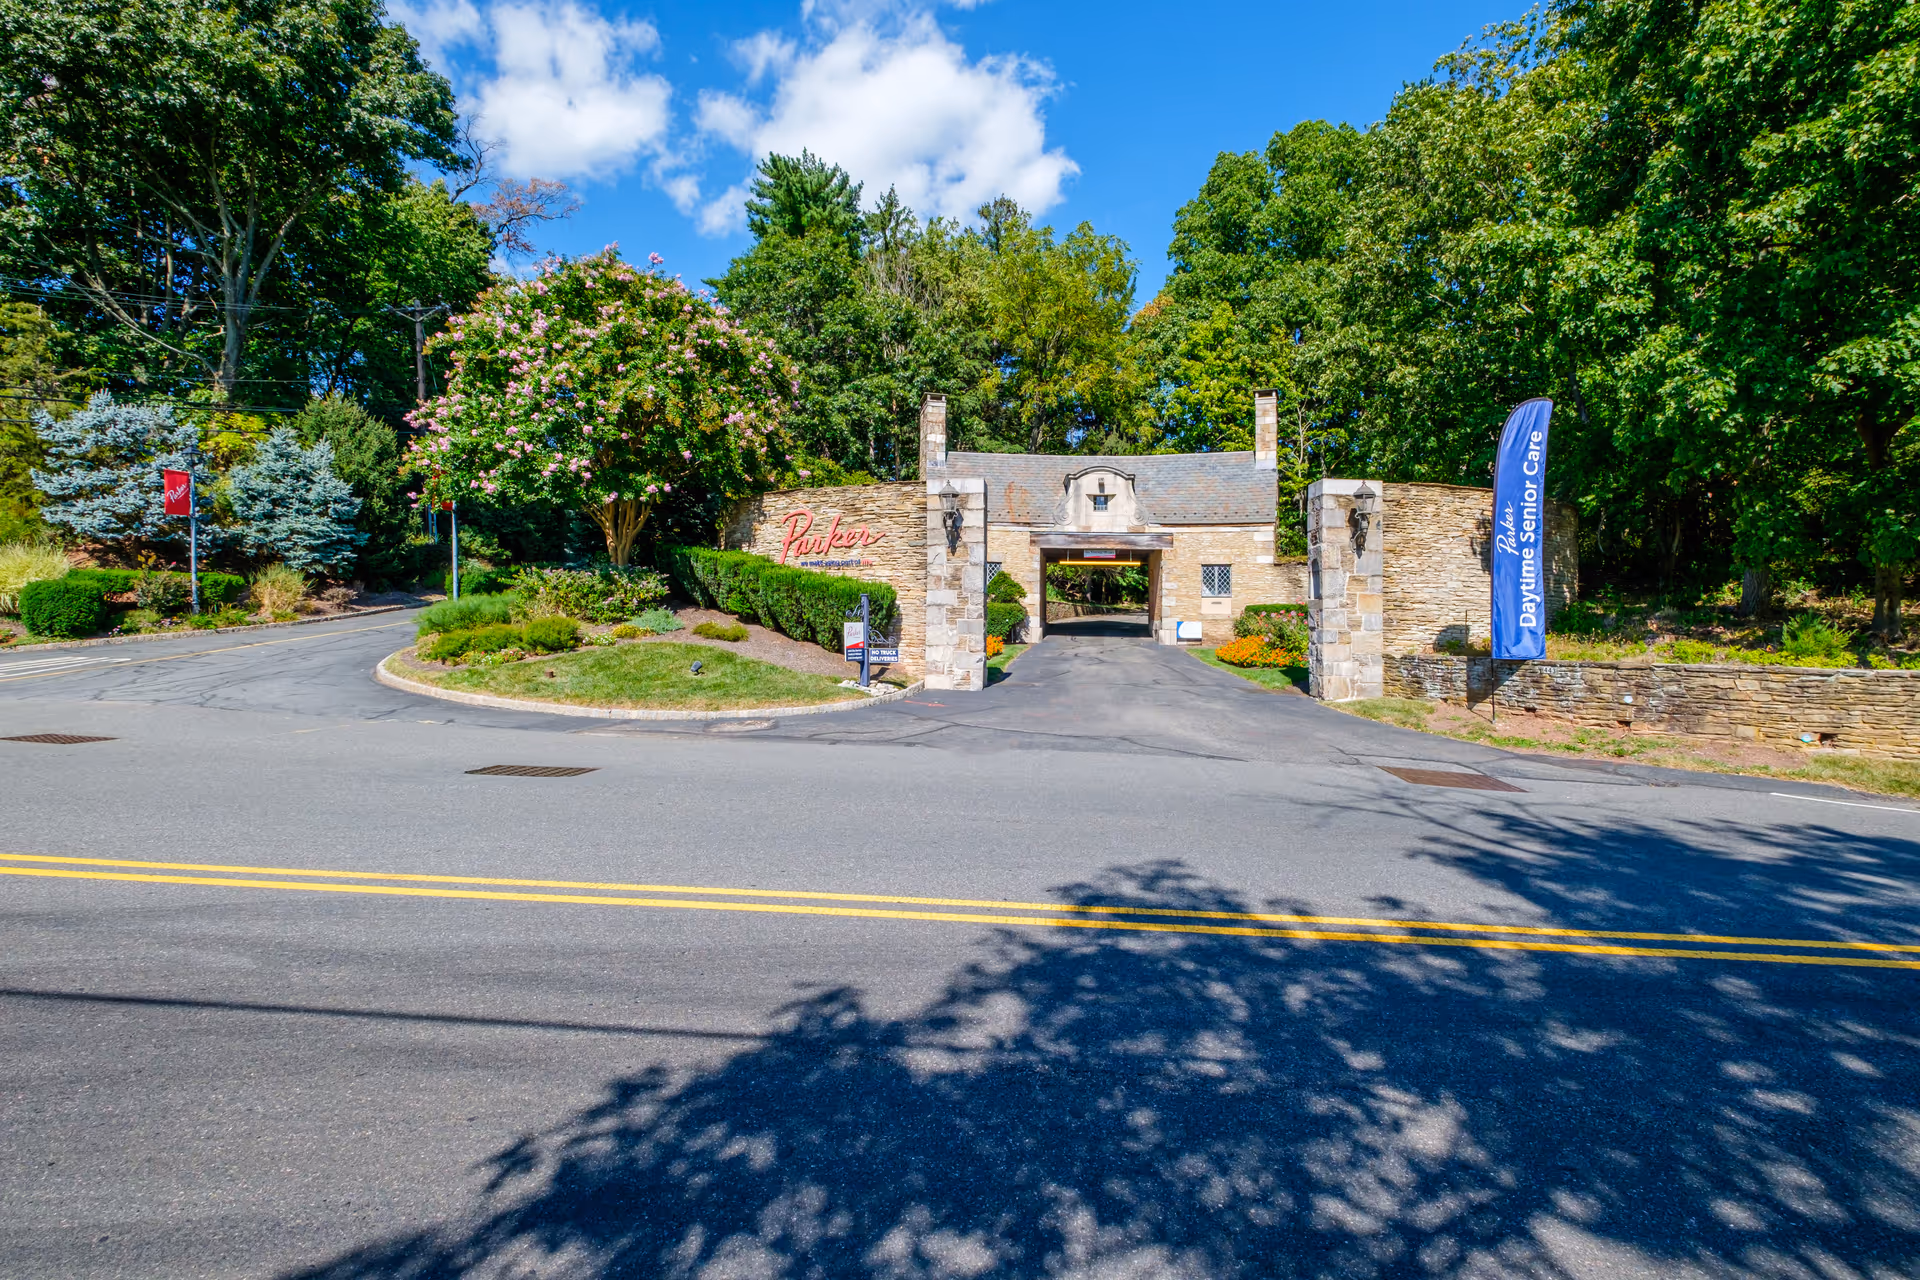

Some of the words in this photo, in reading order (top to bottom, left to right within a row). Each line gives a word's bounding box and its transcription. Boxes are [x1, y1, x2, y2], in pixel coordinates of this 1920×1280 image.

[1523, 430, 1543, 476] Care
[779, 509, 886, 565] Parker
[1497, 501, 1519, 556] Parker
[1520, 480, 1537, 543] Senior
[1520, 548, 1540, 628] Daytime
